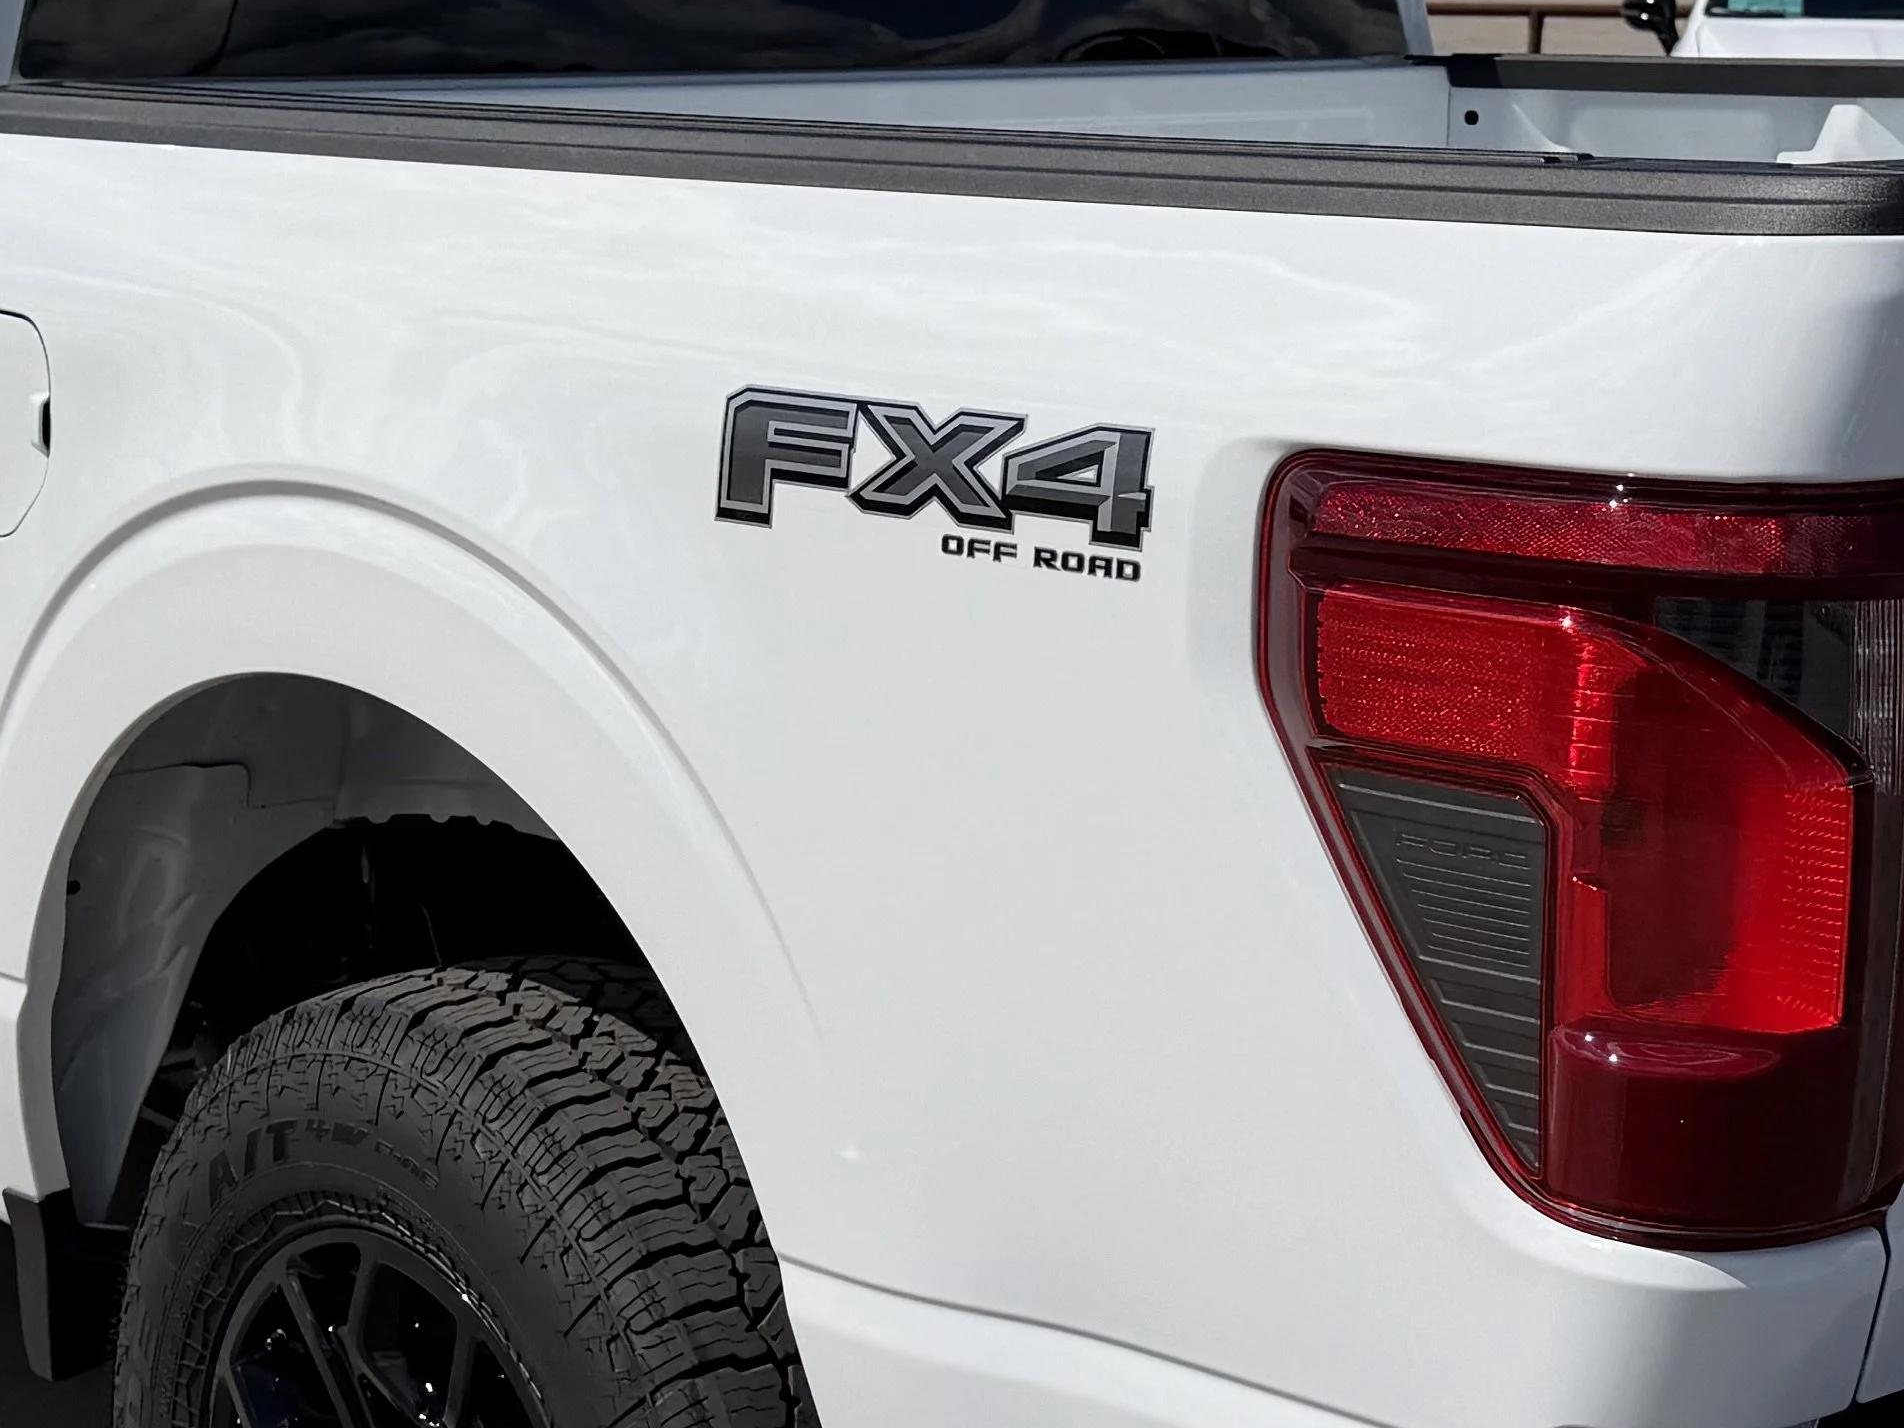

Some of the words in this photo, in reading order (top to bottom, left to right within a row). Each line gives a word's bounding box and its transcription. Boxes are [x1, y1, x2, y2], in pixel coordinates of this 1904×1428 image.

[714, 384, 1155, 552] FX4
[941, 533, 1018, 563] OFF
[1033, 545, 1142, 583] ROAD
[1395, 831, 1530, 870] FORD
